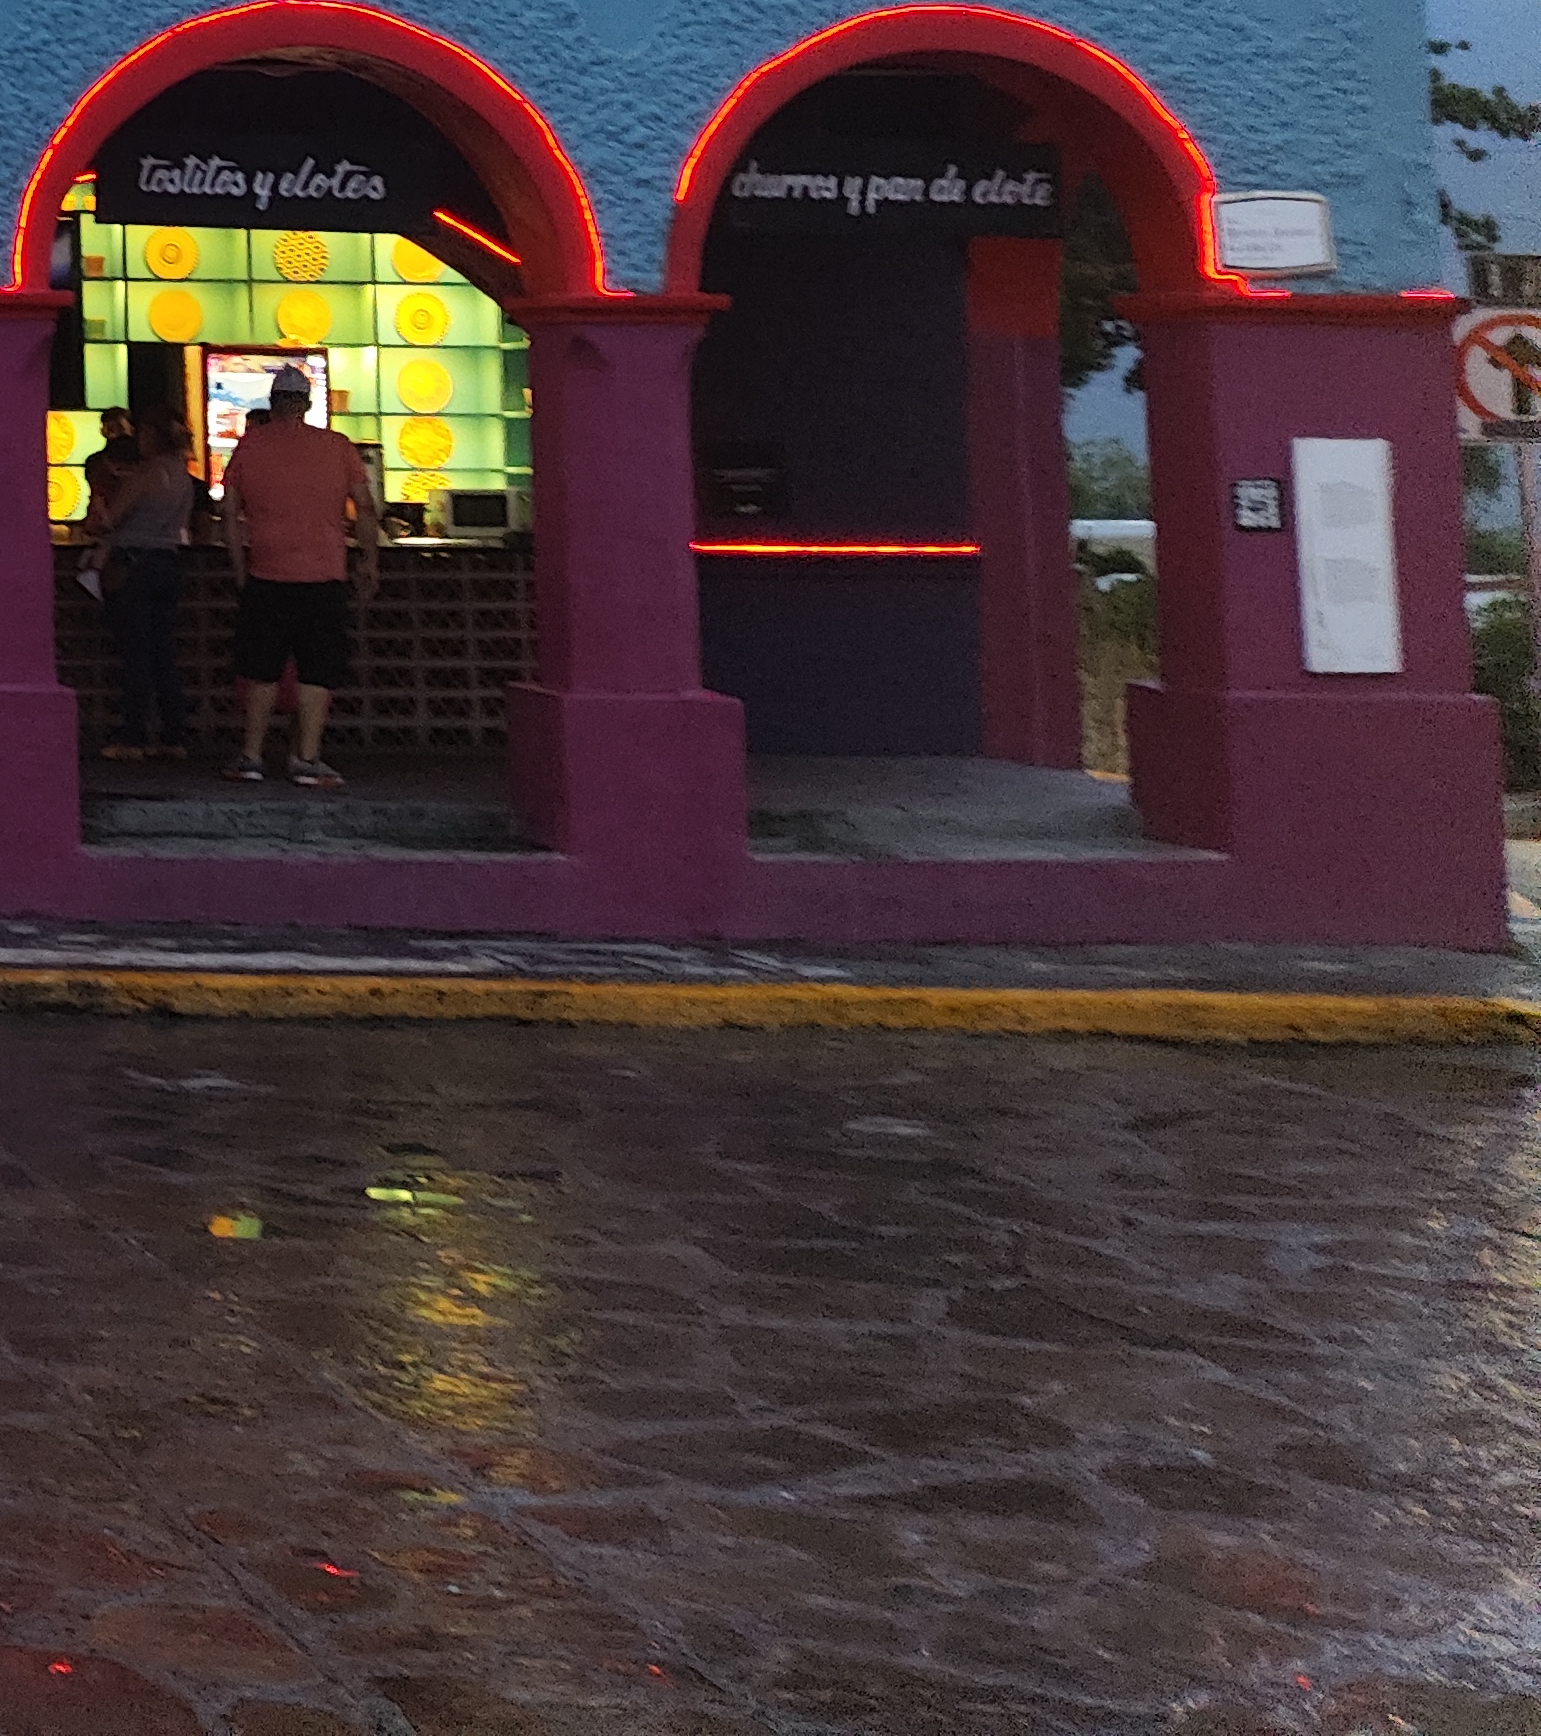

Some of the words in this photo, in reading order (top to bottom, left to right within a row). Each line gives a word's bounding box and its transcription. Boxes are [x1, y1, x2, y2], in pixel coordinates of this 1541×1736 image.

[252, 169, 276, 211] y
[277, 155, 387, 201] elotes
[843, 174, 865, 216] y
[865, 174, 926, 215] pan
[928, 163, 967, 202] de
